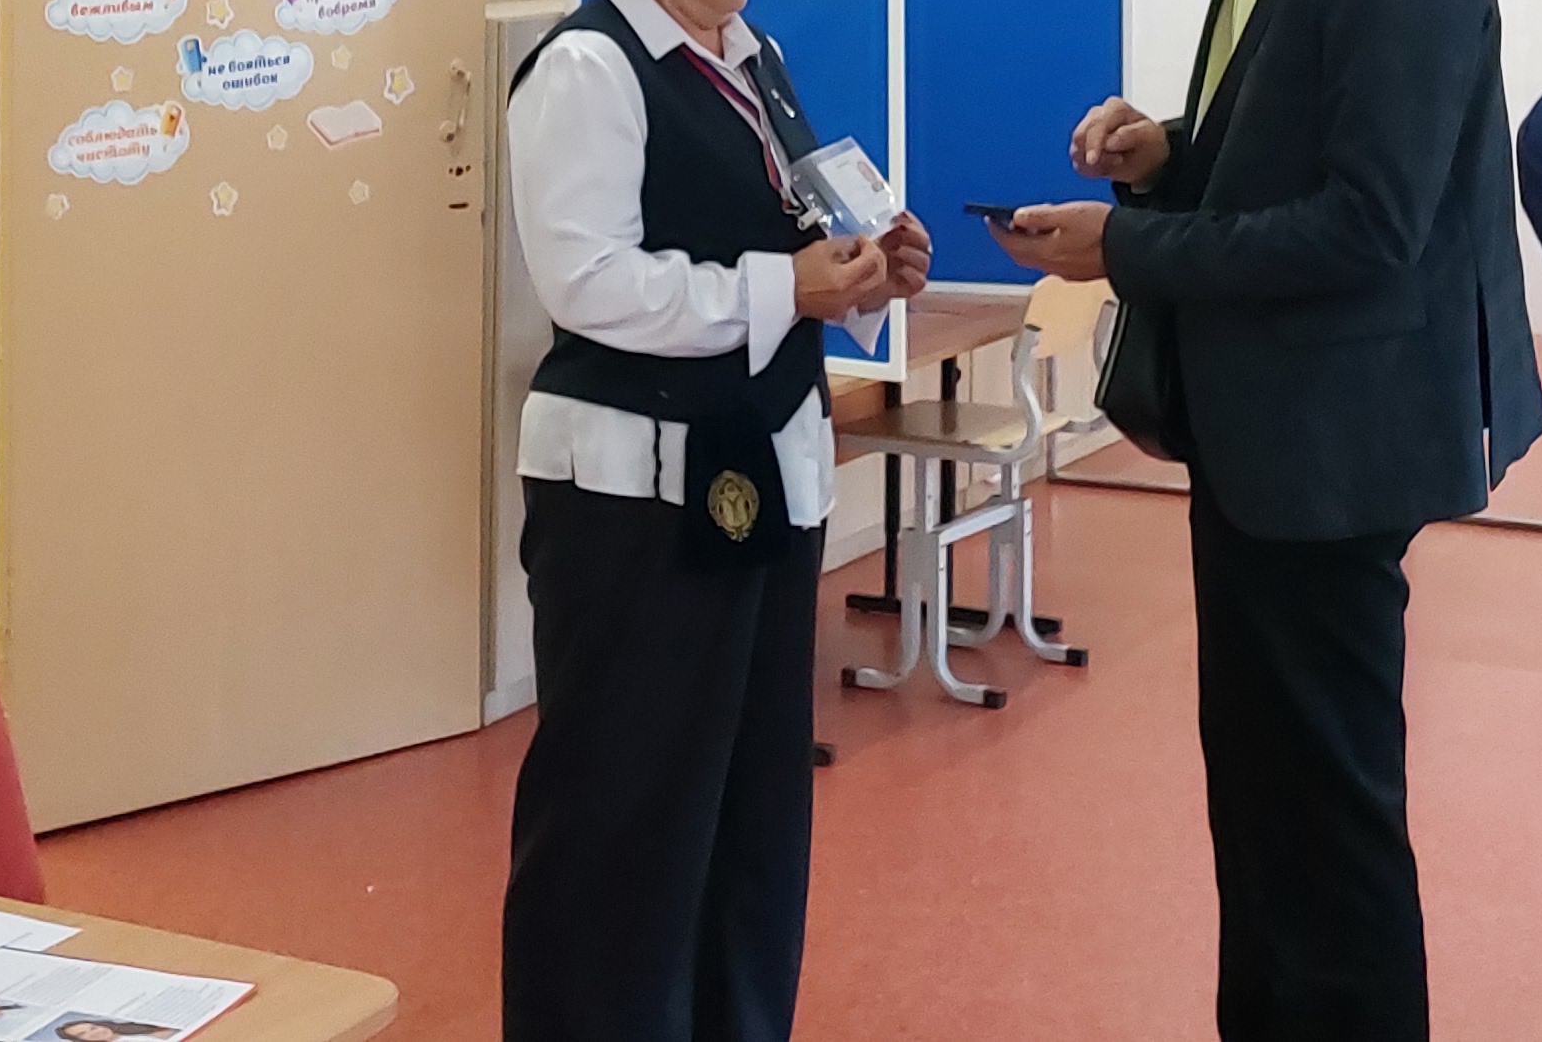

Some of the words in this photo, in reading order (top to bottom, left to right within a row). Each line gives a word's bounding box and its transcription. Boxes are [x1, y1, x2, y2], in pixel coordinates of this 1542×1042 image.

[71, 0, 153, 16] вежливым
[208, 64, 225, 76] не
[229, 55, 290, 73] бояться
[223, 73, 278, 90] ошибок
